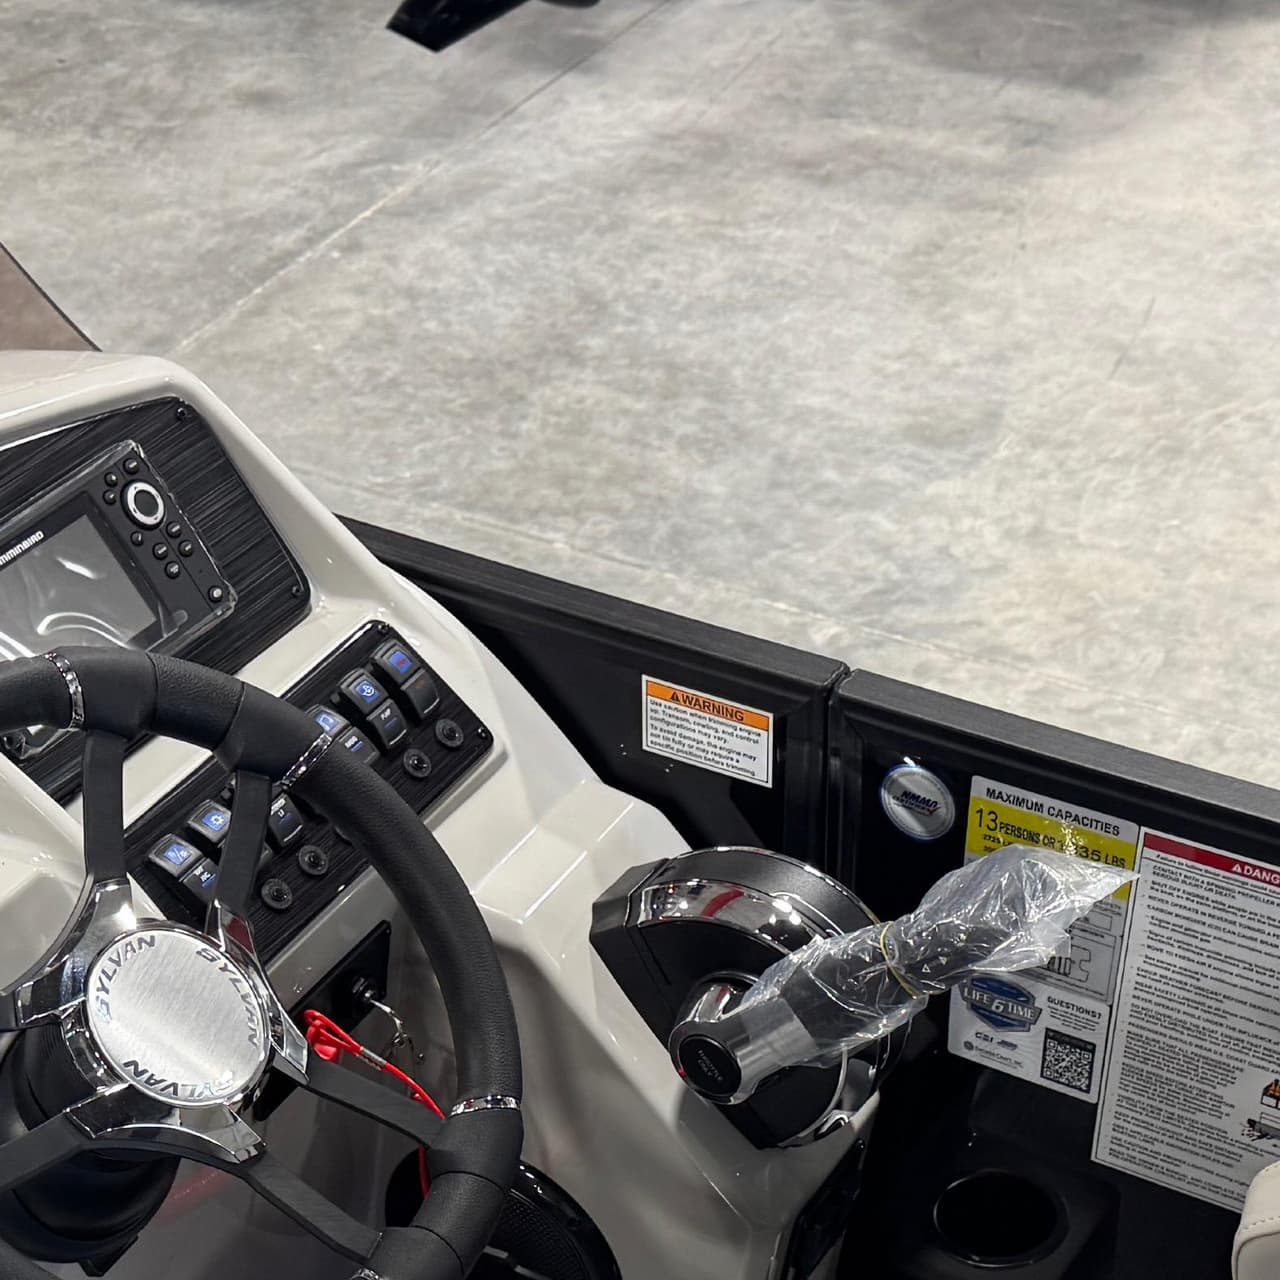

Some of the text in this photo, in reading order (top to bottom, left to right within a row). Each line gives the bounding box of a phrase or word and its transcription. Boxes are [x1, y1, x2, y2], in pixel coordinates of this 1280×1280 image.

[649, 699, 661, 708] Use
[664, 703, 687, 716] caution
[689, 710, 706, 721] when
[739, 725, 760, 737] engine
[682, 694, 743, 722] WARNING
[649, 731, 660, 740] not
[672, 737, 685, 748] fully
[687, 742, 693, 750] or
[695, 744, 708, 754] may
[710, 749, 733, 762] require
[735, 756, 739, 764] a
[650, 723, 657, 732] To
[659, 726, 676, 737] avoid
[707, 740, 717, 749] the
[719, 743, 741, 756] engine
[742, 750, 756, 761] may
[697, 728, 710, 738] may
[722, 727, 733, 737] and
[735, 731, 759, 745] control
[650, 739, 674, 752] specific
[675, 746, 702, 761] position
[703, 755, 724, 767] before
[985, 787, 1120, 837] MAXIMUM CAPACITIES
[974, 805, 999, 832] 13
[998, 821, 1041, 844] PERSONS
[1041, 834, 1056, 848] OR
[1104, 853, 1126, 869] LBS
[96, 935, 156, 1024] SYLVAN
[196, 948, 261, 1048] SYLVAN
[963, 986, 1034, 1020] LIFE 6 TIME
[1047, 995, 1101, 1020] QUESTIONS?
[123, 1059, 236, 1101] SYLVAN
